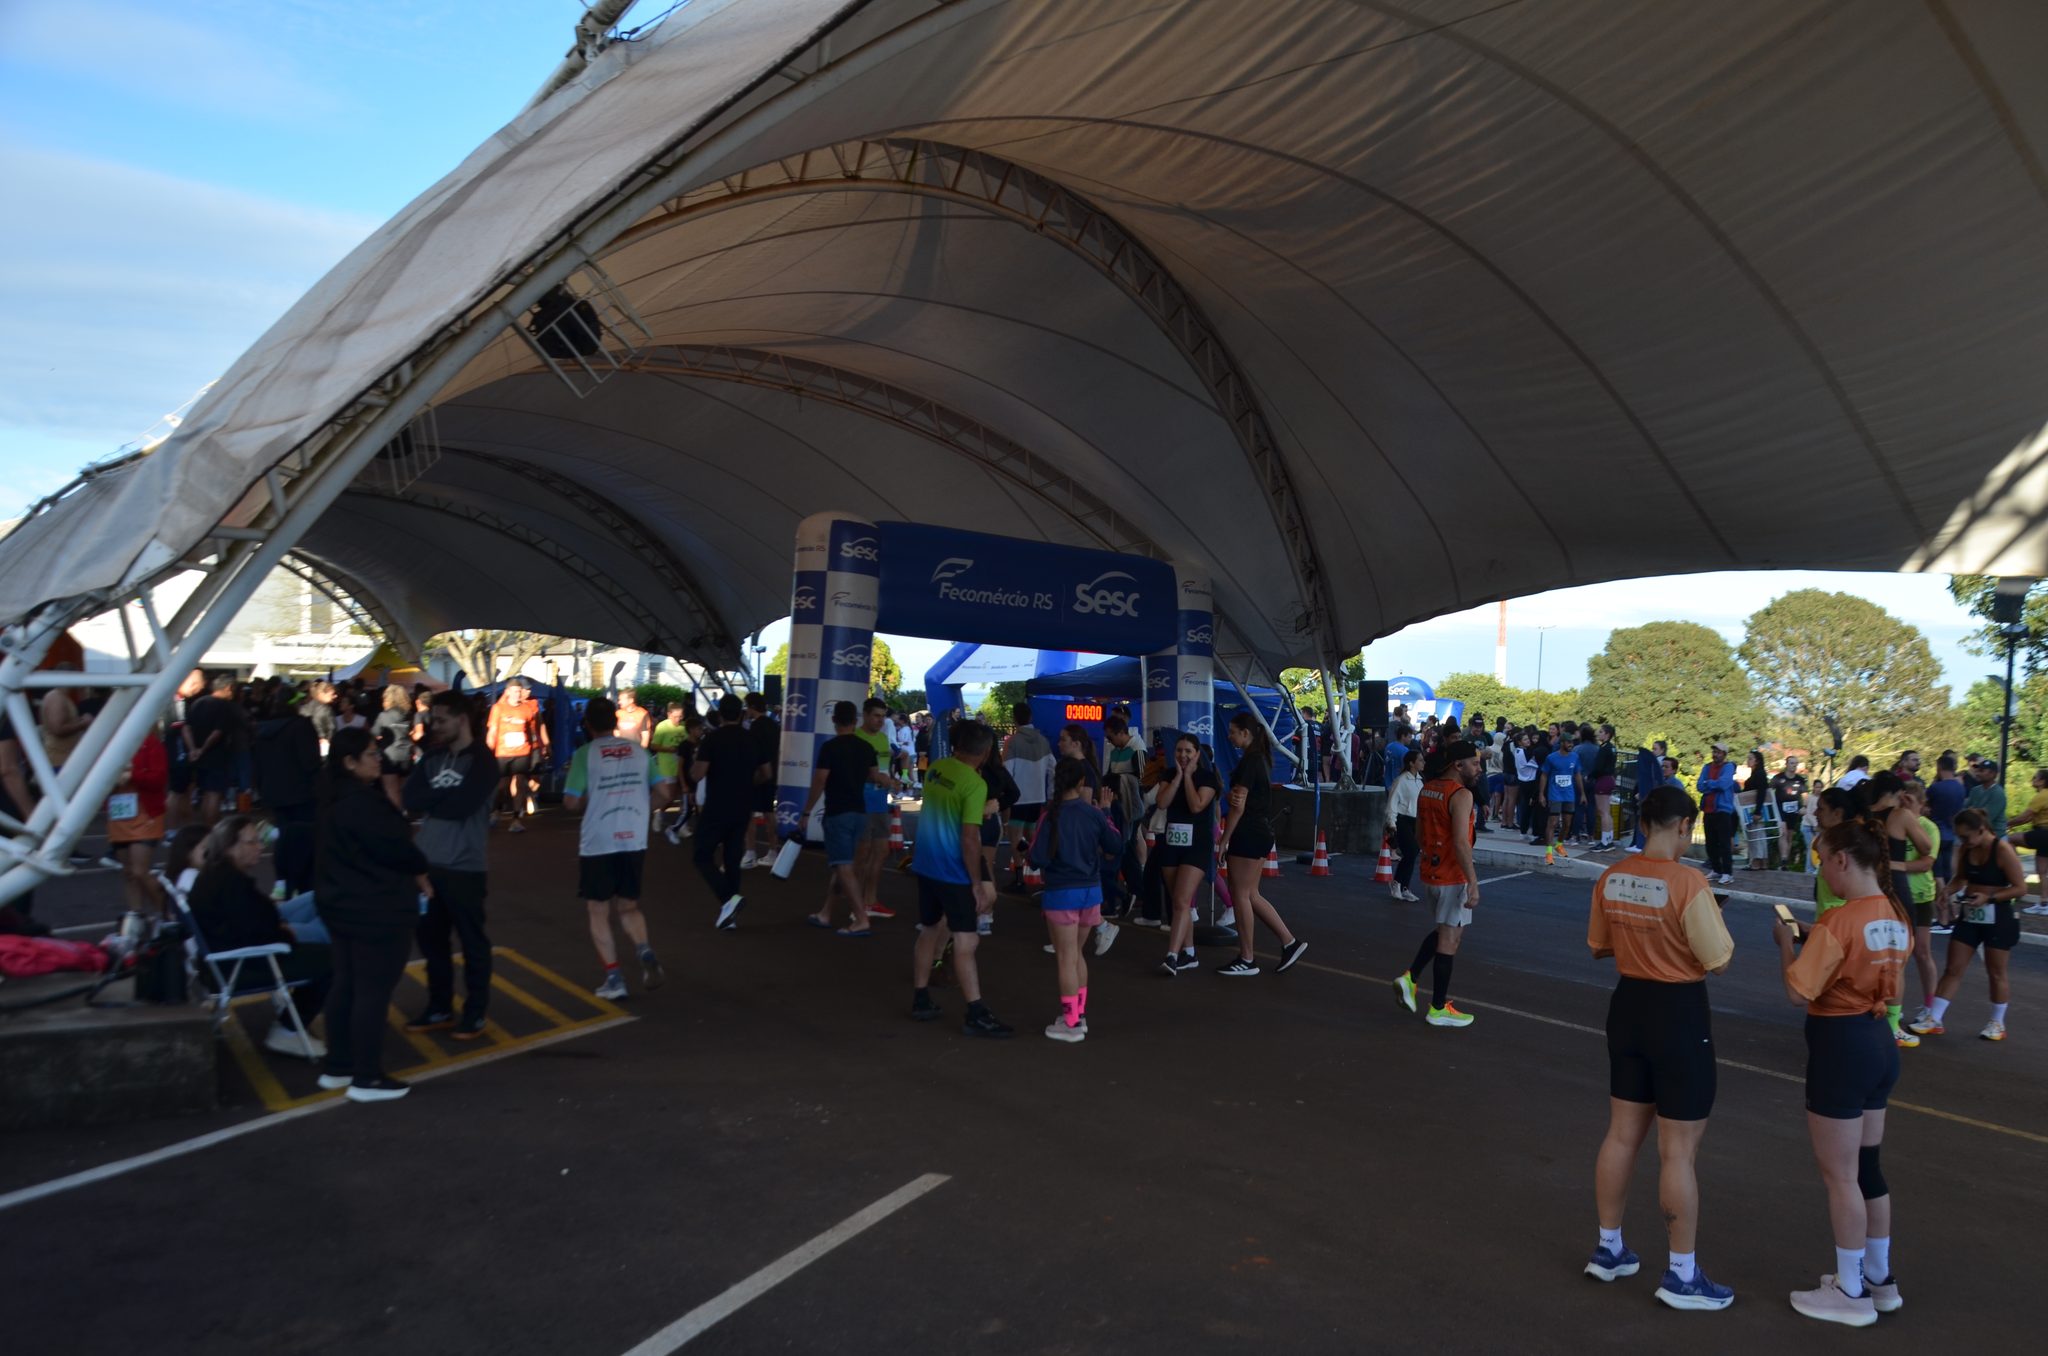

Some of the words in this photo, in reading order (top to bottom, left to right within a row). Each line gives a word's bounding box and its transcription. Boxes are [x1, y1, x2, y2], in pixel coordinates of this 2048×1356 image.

[795, 586, 816, 609] esc
[939, 582, 1029, 608] Fecomércio
[1033, 592, 1053, 610] RS
[1072, 571, 1140, 617] Sesc
[1148, 669, 1171, 689] esc
[786, 693, 808, 717] esc
[1168, 831, 1188, 844] 293
